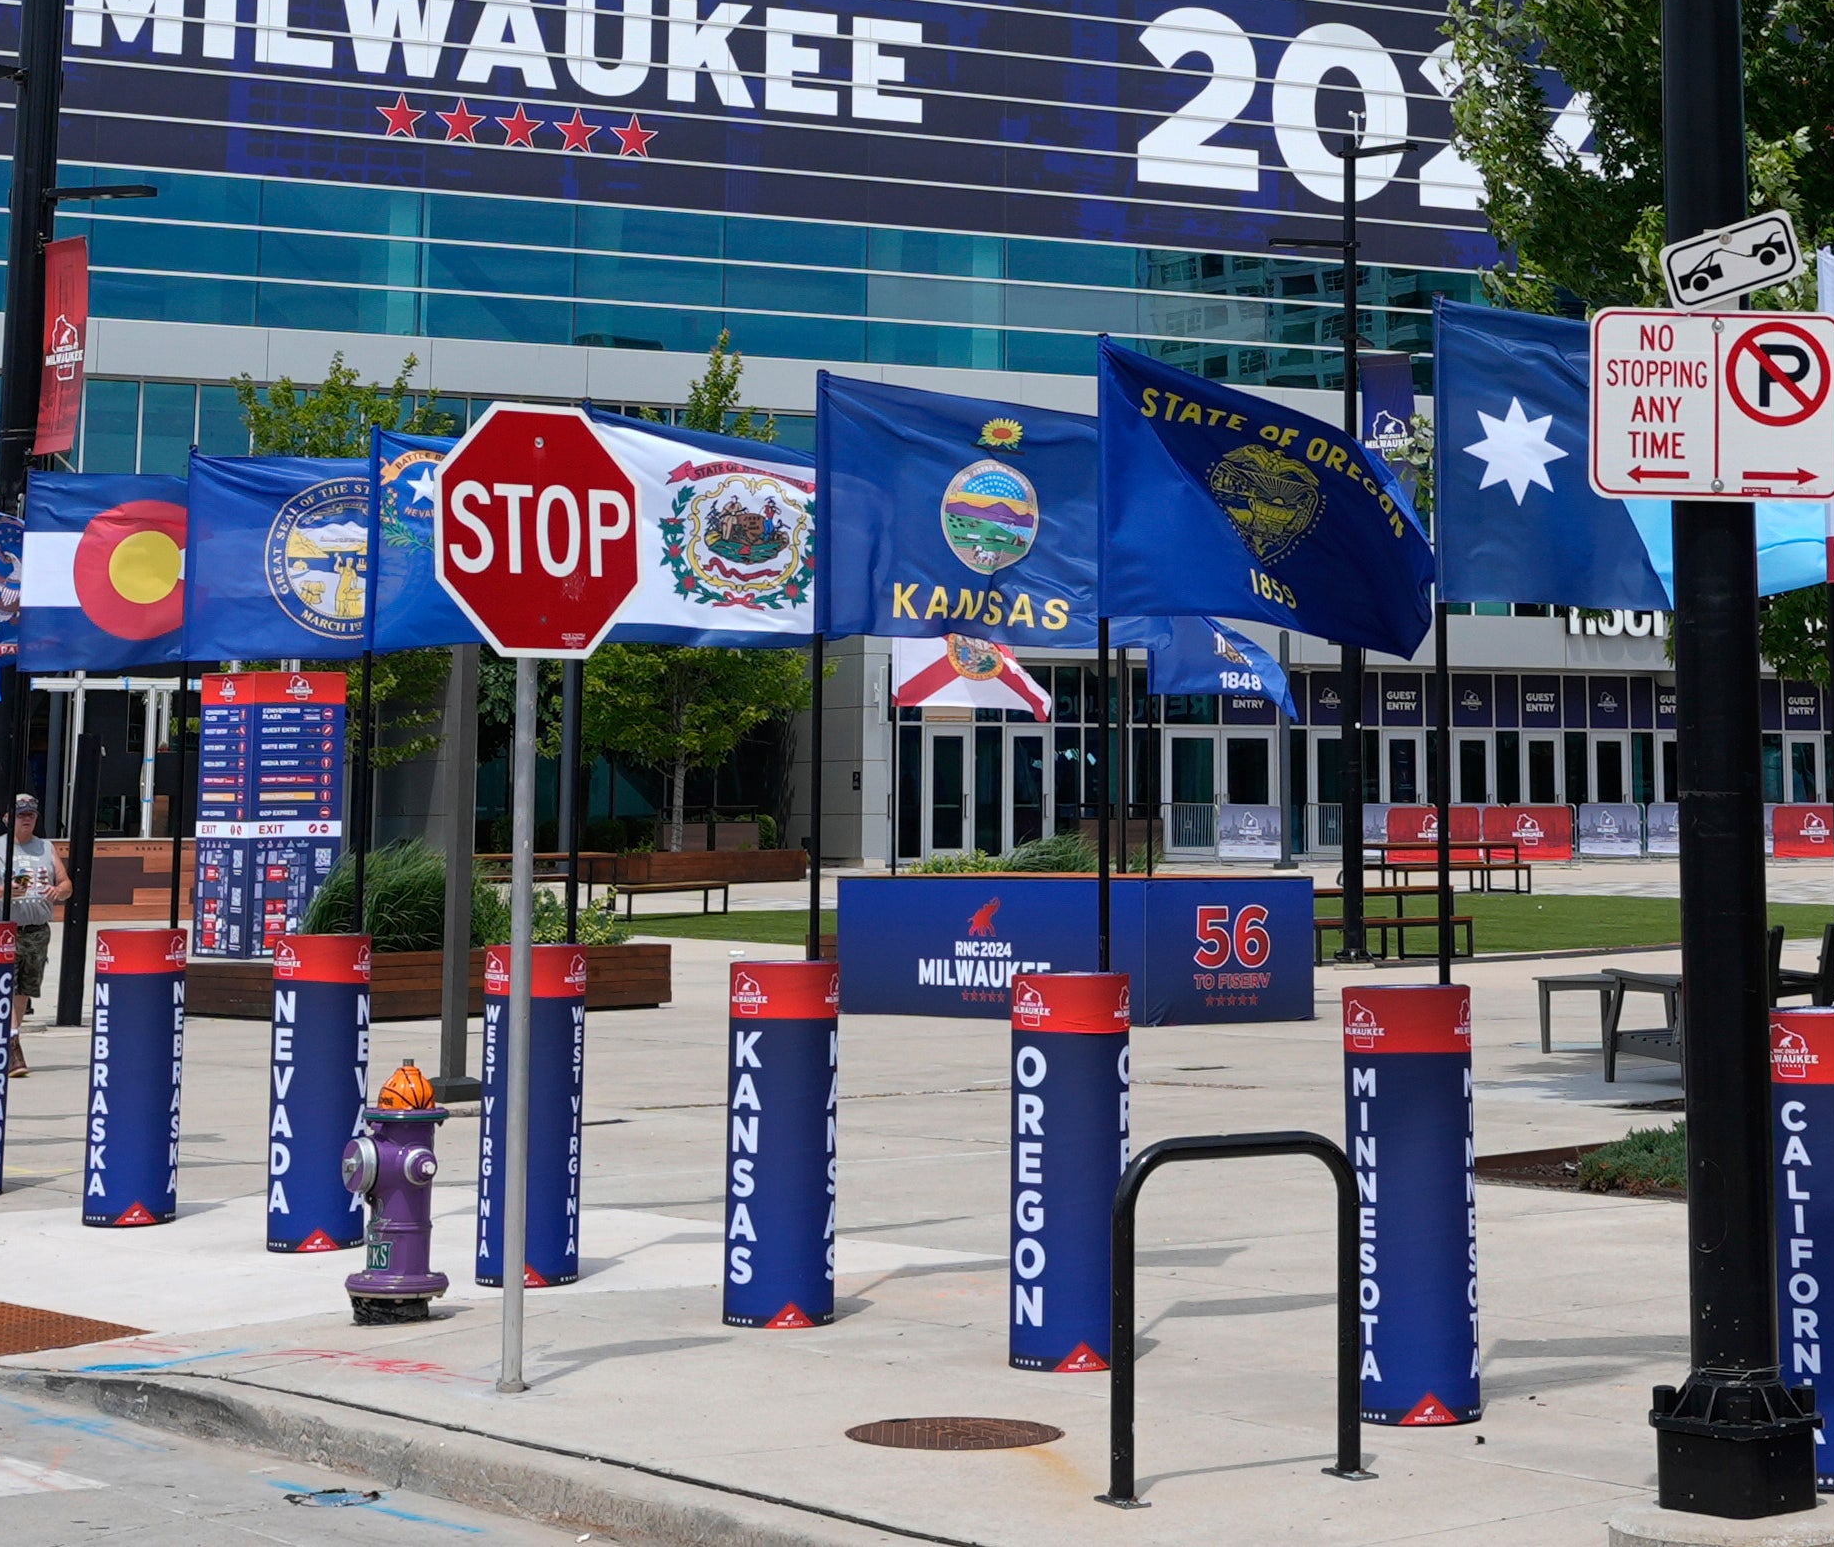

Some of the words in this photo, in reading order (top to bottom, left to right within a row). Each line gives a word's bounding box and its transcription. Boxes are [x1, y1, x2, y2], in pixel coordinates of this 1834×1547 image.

[1640, 324, 1675, 352] NO
[1606, 359, 1708, 389] STOPPING
[1631, 396, 1682, 423] ANY
[1627, 431, 1686, 460] TIME
[396, 451, 430, 471] BATTLE
[694, 463, 724, 478] STATE
[1140, 387, 1249, 432] STATE
[1259, 425, 1300, 448] OF
[1306, 437, 1405, 539] OREGON
[299, 495, 316, 509] OF
[318, 483, 349, 499] THE
[275, 507, 299, 541] SEAL
[449, 479, 631, 578] STOP
[272, 546, 290, 596] GREAT
[1249, 567, 1298, 610] 1859
[892, 582, 1070, 631] KANSAS
[299, 609, 346, 633] MARCH
[1219, 670, 1262, 692] 1848
[1232, 699, 1265, 709] ENTRY
[1386, 690, 1417, 701] GUEST
[1386, 701, 1417, 711] ENTRY
[1525, 692, 1556, 703] GUEST
[1525, 703, 1556, 713] ENTRY
[1659, 694, 1677, 704] GUE
[1659, 704, 1677, 714] ENT
[1788, 696, 1816, 706] GUEST
[1788, 706, 1816, 716] ENTRY
[201, 825, 217, 834] EXIT
[258, 824, 285, 834] EXIT
[1193, 904, 1271, 969] 56
[1193, 973, 1215, 990] TO
[1218, 971, 1271, 989] FISERV
[485, 1003, 502, 1086] WEST
[571, 1004, 585, 1085] WEST
[1770, 1054, 1819, 1065] LWAUKEE
[87, 982, 109, 1198] NEBRASKA
[166, 980, 185, 1194] NEBRASKA
[268, 990, 297, 1216] NEVADA
[349, 993, 370, 1213] NEVAA
[729, 1030, 764, 1285] KANSAS
[478, 1096, 495, 1259] VIRGINIA
[566, 1094, 581, 1256] VIRGINIA
[1014, 1045, 1048, 1328] OREGON
[1352, 1066, 1383, 1384] MINNESOTA
[1779, 1100, 1827, 1446] CALIFORN
